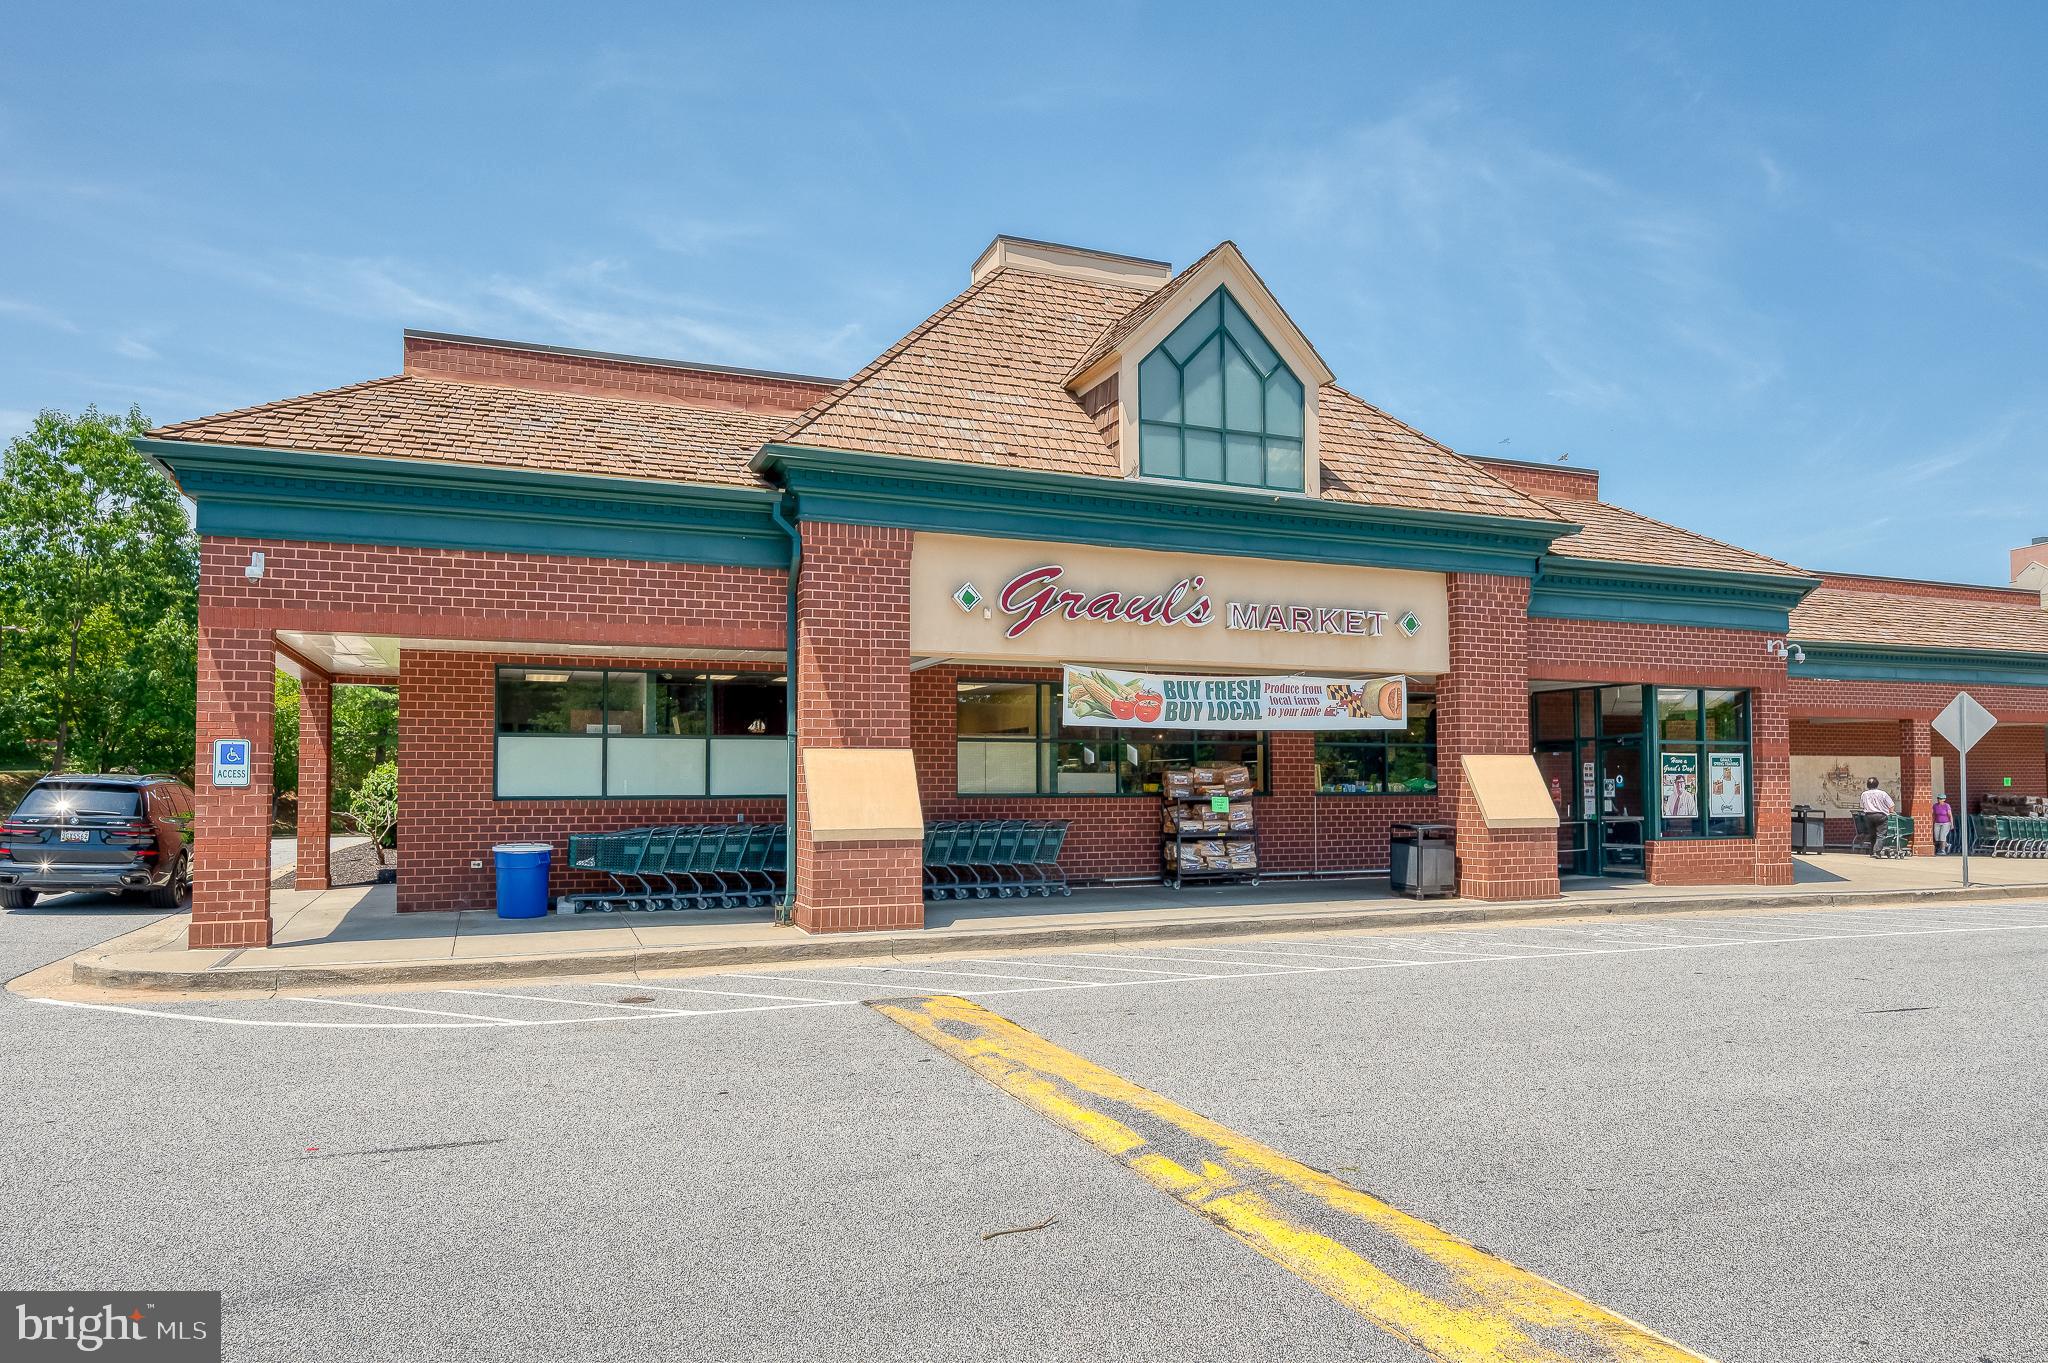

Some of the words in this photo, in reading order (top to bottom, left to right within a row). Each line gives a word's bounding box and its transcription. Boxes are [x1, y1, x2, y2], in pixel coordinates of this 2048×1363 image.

[999, 565, 1215, 638] Graul's
[1225, 602, 1389, 637] MARKET
[1164, 680, 1202, 700] BUY
[1205, 679, 1262, 700] FRESH
[1264, 683, 1300, 694] Produce
[1302, 684, 1323, 695] from
[1269, 696, 1292, 706] local
[1294, 696, 1320, 706] farms
[1165, 701, 1203, 721] BUY
[1207, 701, 1262, 721] LOCAL
[1268, 707, 1277, 717] to
[1278, 707, 1299, 718] your
[1300, 707, 1322, 717] table
[1682, 764, 1695, 772] Day!
[217, 769, 246, 779] ACCESS
